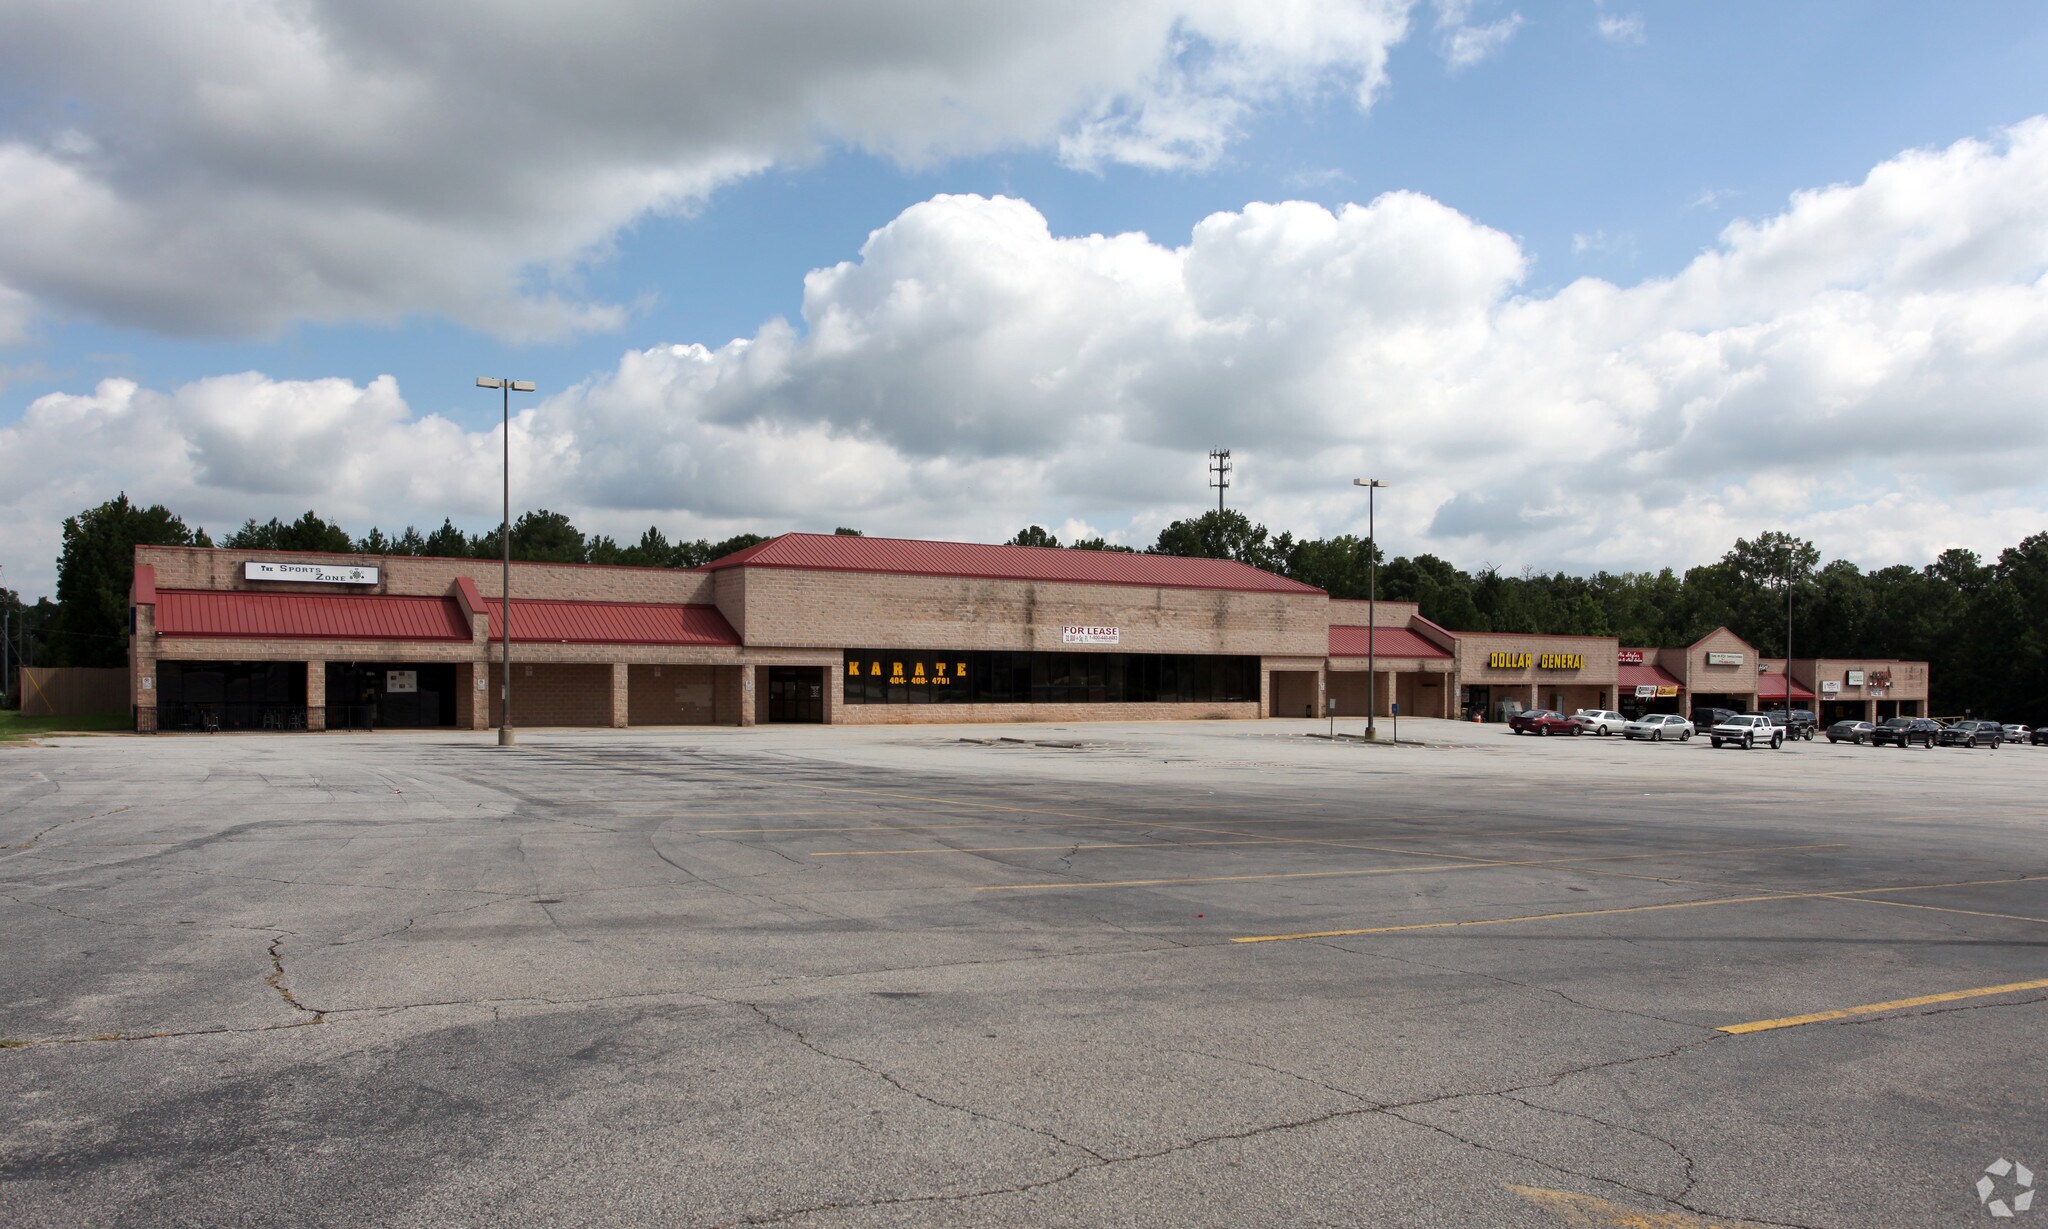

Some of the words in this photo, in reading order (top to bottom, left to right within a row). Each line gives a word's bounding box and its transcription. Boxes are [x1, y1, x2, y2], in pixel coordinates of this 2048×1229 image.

[280, 564, 322, 573] SPORTS
[315, 573, 346, 582] ZONE
[1064, 626, 1084, 634] FOR
[1087, 627, 1117, 635] LEASE
[1490, 652, 1532, 668] DOLLAR
[1540, 653, 1585, 669] GENERAL
[848, 661, 966, 676] KARATE
